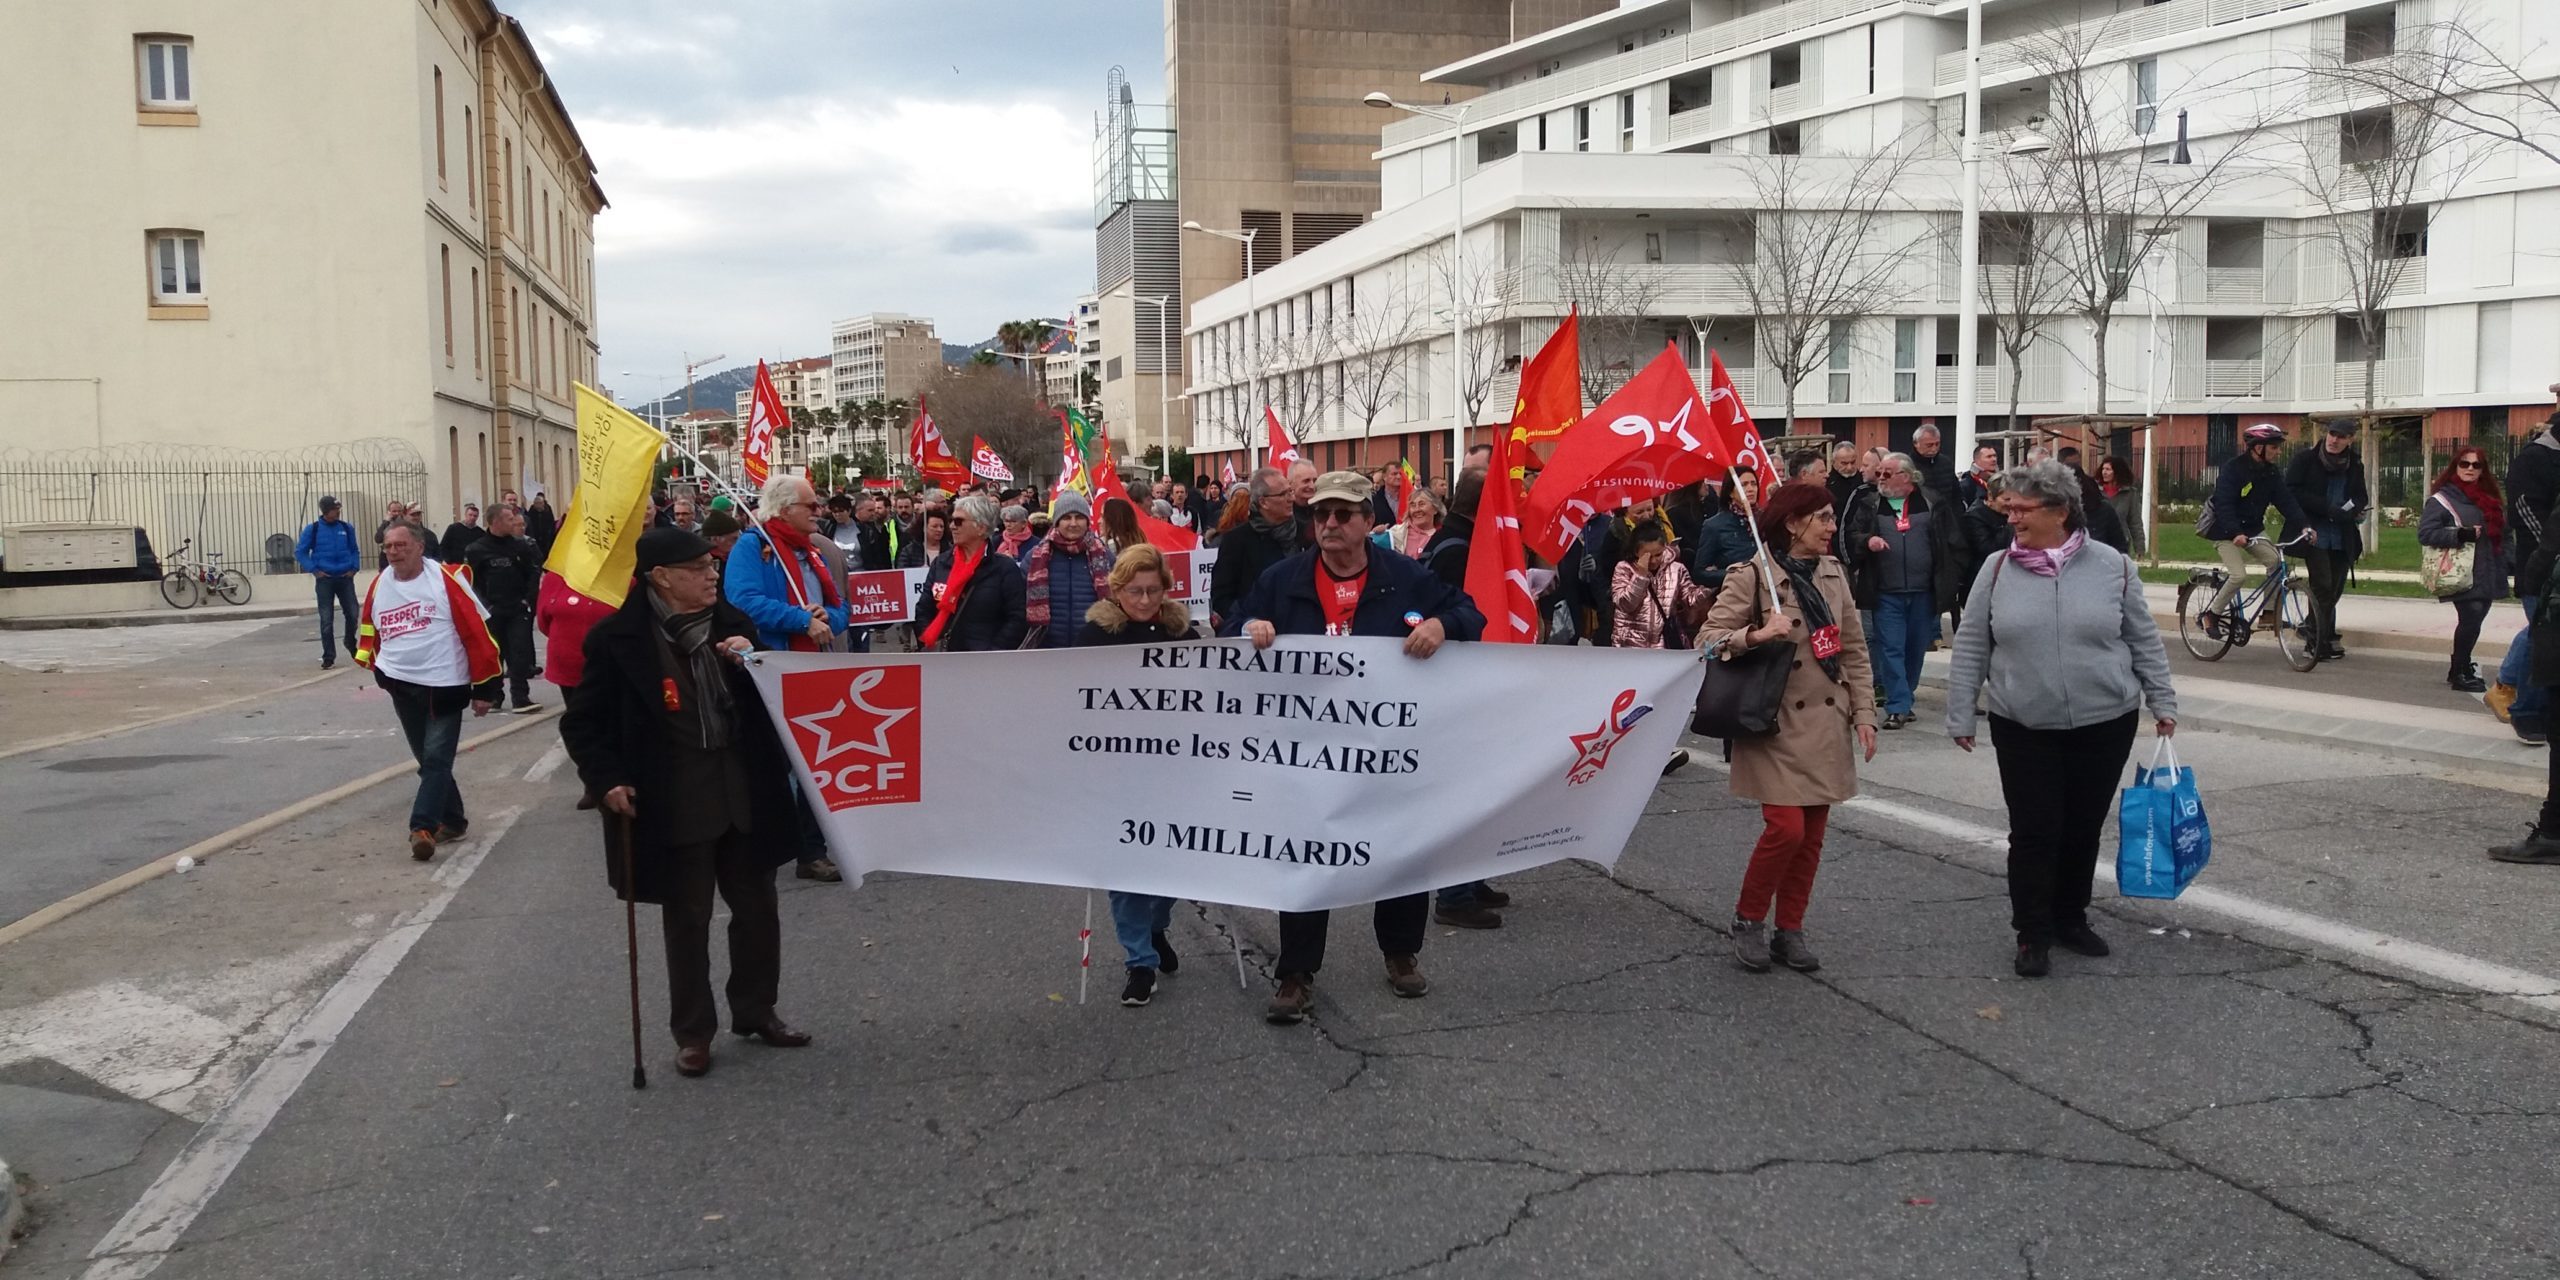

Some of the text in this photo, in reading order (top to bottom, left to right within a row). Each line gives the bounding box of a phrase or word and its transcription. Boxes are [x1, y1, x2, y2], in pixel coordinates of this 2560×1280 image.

[592, 445, 604, 479] SANS
[973, 465, 1011, 479] TOULON
[857, 585, 885, 596] MAL
[380, 605, 421, 628] RESPECT
[852, 599, 900, 615] RAITÉ·E
[1140, 646, 1367, 678] RETRAITES:
[1078, 688, 1419, 728] TAXER la FINANCE
[1068, 734, 1420, 774] comme les SALAIRES
[1588, 739, 1609, 755] 83
[810, 761, 906, 794] PCF
[1567, 770, 1597, 787] PCF
[827, 797, 869, 807] OMMUNISTE
[1119, 819, 1371, 867] 30 MILLIARDS
[2143, 807, 2155, 886] www.laforet.com
